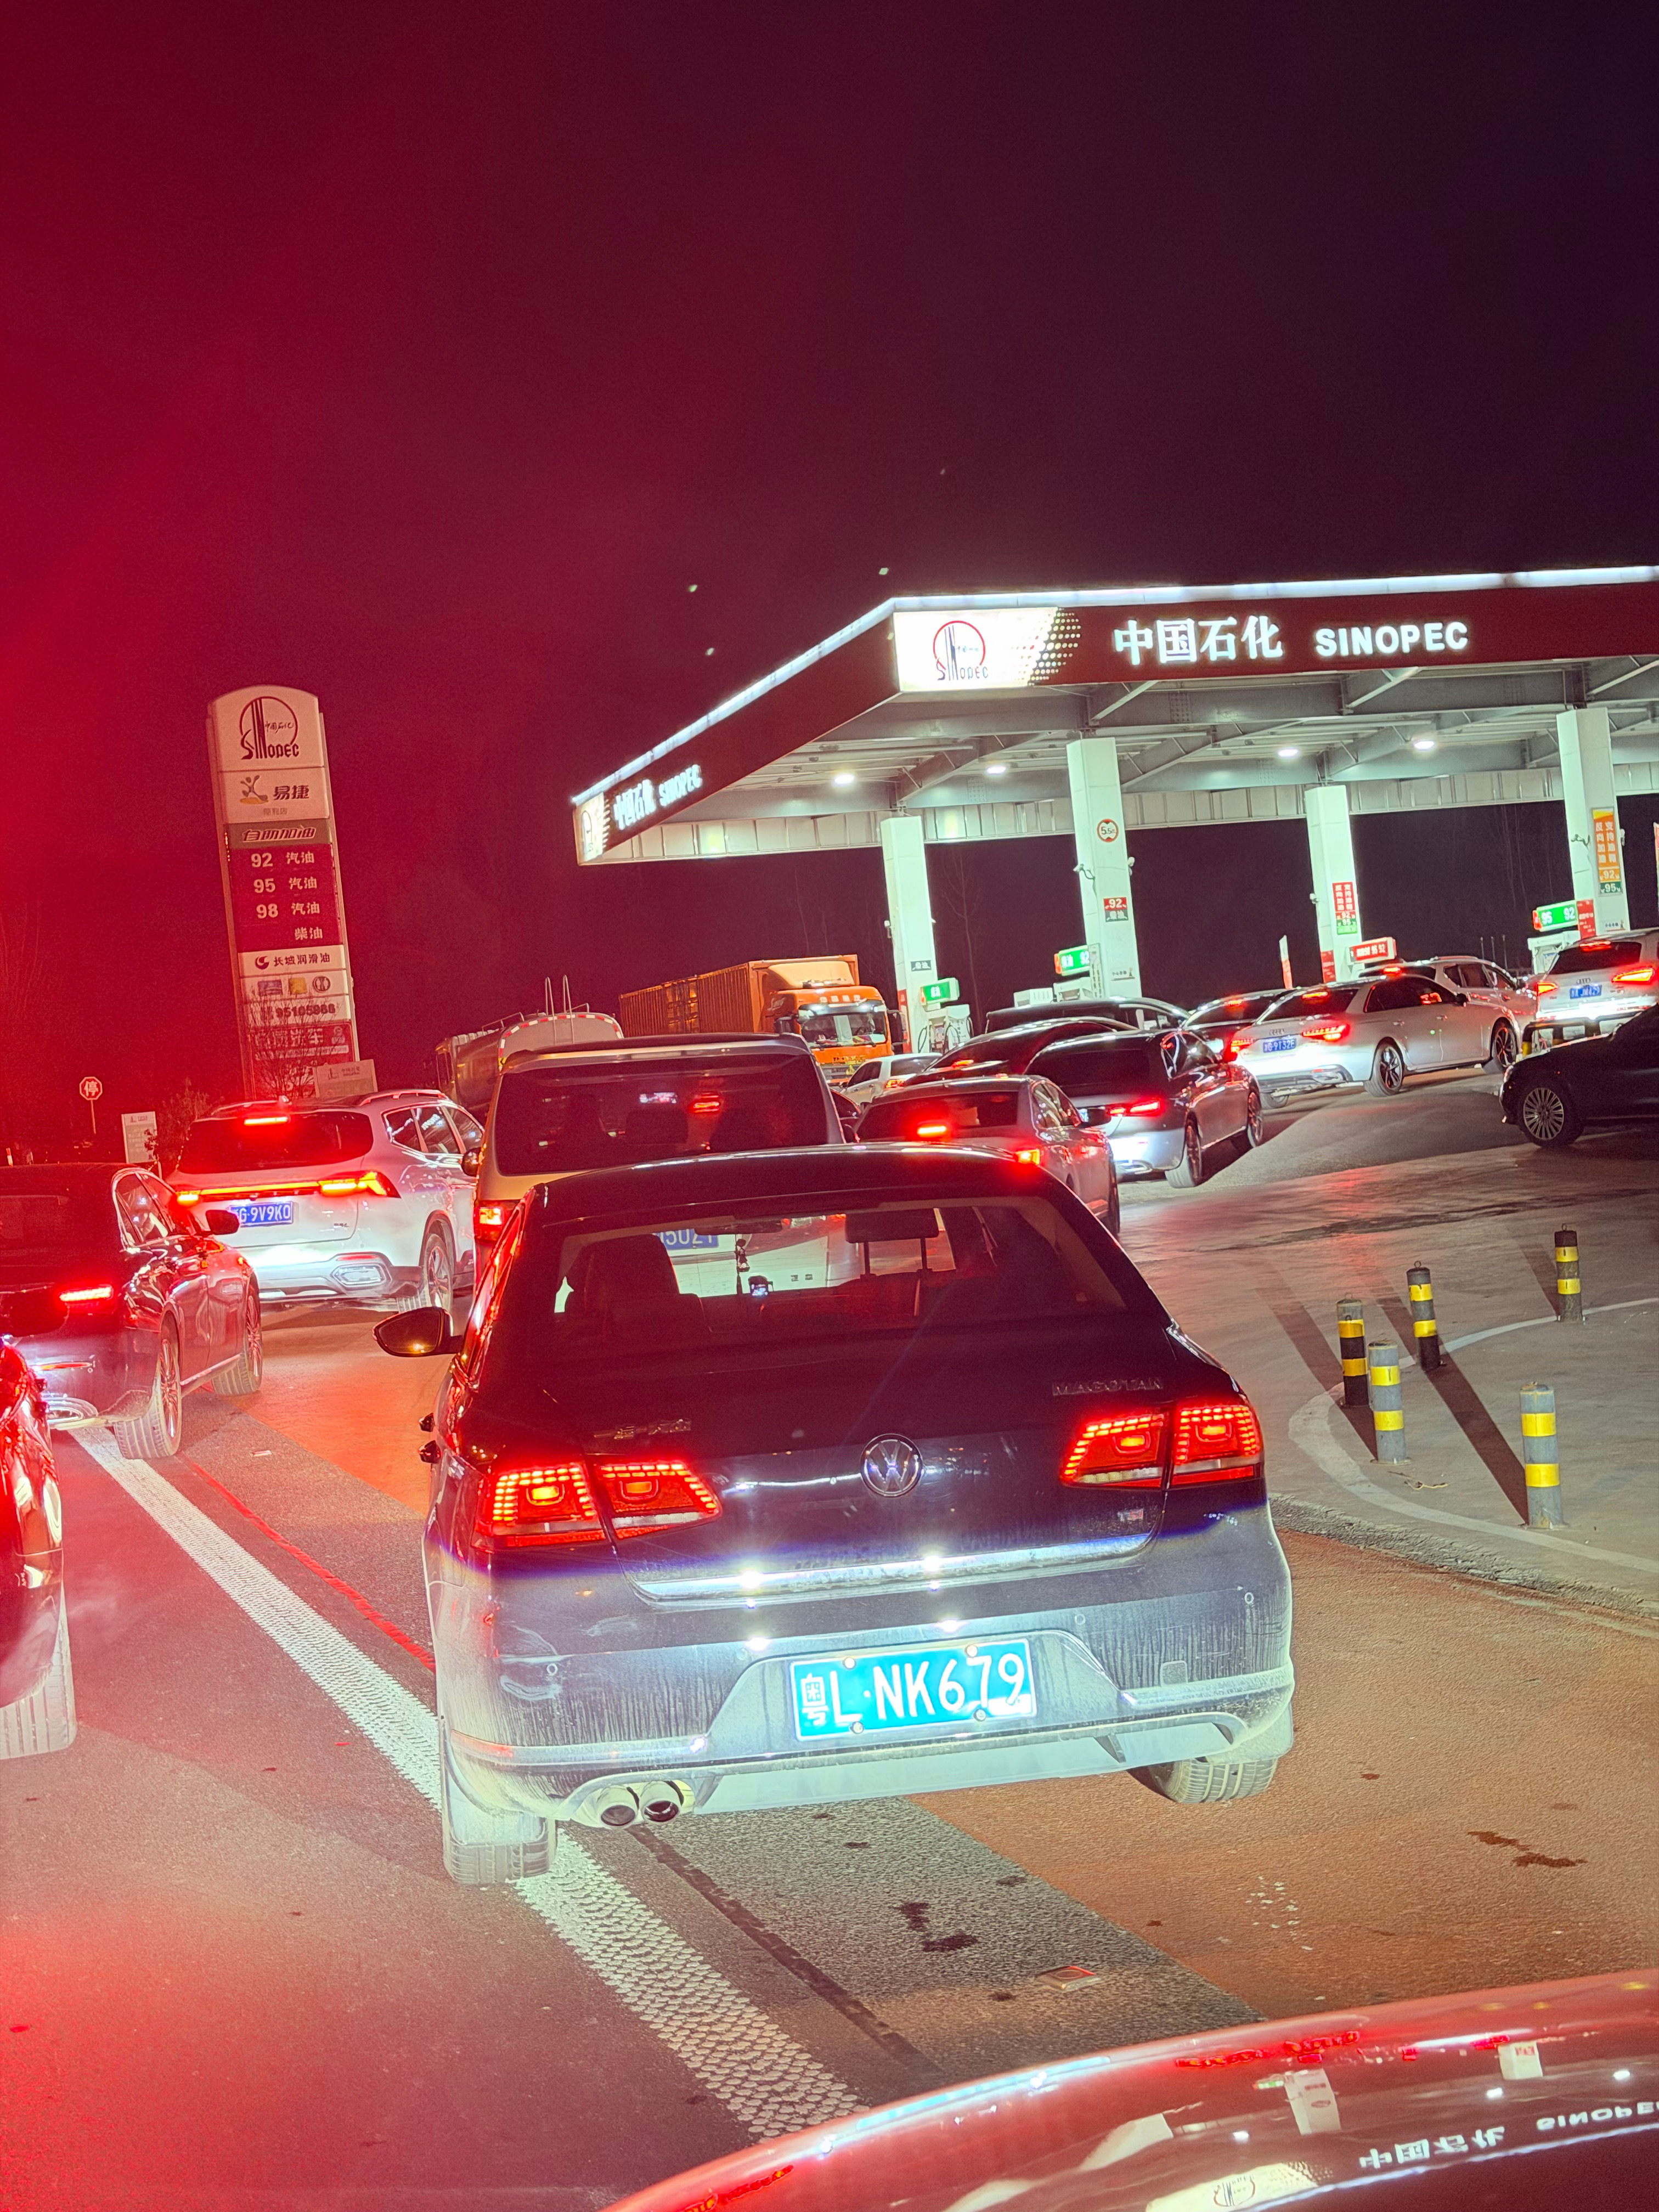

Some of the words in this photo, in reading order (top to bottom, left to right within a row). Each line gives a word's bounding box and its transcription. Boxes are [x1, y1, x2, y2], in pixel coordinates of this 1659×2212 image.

[1114, 615, 1283, 665] 中国石化
[1316, 622, 1468, 657] SINOPEC
[273, 785, 309, 800] 易捷
[658, 764, 703, 806] SINOPEC
[242, 825, 316, 842] 自助加油
[251, 853, 273, 867] 92
[286, 851, 315, 865] 汽油
[1603, 870, 1615, 879] 92
[253, 878, 276, 893] 95
[289, 876, 318, 890] 汽油
[1605, 883, 1617, 893] 95
[256, 904, 278, 918] 98
[291, 901, 320, 915] 汽油
[1109, 898, 1122, 909] 92
[1541, 911, 1553, 924] 95
[1564, 907, 1576, 921] 92
[295, 927, 323, 941] 柴油
[273, 952, 331, 967] 长城润滑油
[1080, 951, 1090, 965] 92
[84, 1080, 99, 1097] 停
[232, 1204, 291, 1223] G·9V9K0
